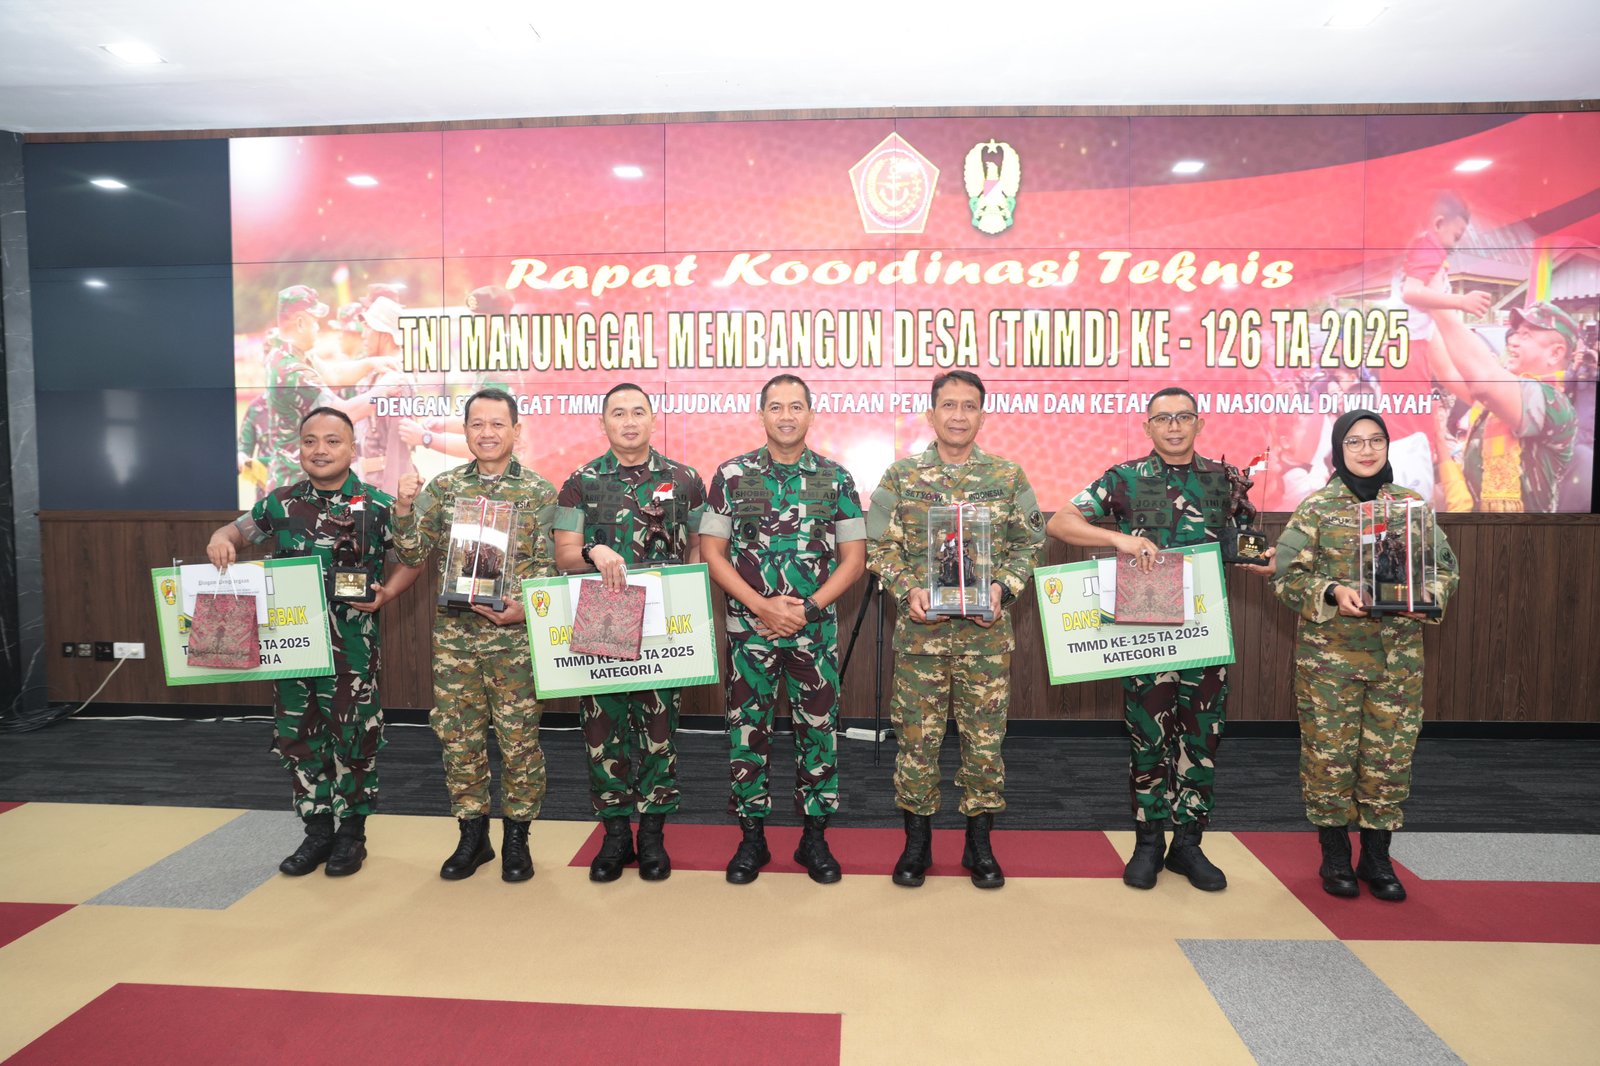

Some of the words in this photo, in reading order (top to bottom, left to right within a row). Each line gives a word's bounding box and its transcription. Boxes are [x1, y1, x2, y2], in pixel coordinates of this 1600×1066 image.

[505, 254, 698, 297] Rapat
[713, 250, 1081, 288] Koordinasi
[1097, 250, 1294, 292] Teknis
[399, 315, 452, 373] TNI
[459, 311, 659, 373] MANUNGGAL
[667, 309, 884, 371] MEMBANGUN
[894, 308, 979, 369] DESA
[988, 308, 1120, 369] (TMMD)
[1130, 308, 1171, 368] KE
[1200, 308, 1263, 369] 126
[1270, 308, 1312, 368] TA
[1319, 308, 1410, 369] 2025
[1043, 393, 1085, 414] DAN
[1215, 393, 1314, 414] NASIONAL
[1318, 394, 1342, 414] DI
[823, 491, 836, 500] AD
[265, 639, 278, 650] TA
[280, 636, 311, 650] 2025
[1067, 638, 1108, 654] TMMD
[1111, 631, 1156, 649] KE-125
[1157, 630, 1174, 643] TA
[1175, 625, 1209, 641] 2025
[273, 654, 282, 664] A
[554, 654, 595, 668] TMMD
[644, 649, 659, 660] TA
[661, 645, 695, 659] 2025
[1103, 645, 1165, 664] KATEGORI
[1168, 644, 1178, 656] B
[590, 664, 651, 680] KATEGORI
[653, 663, 663, 674] A
